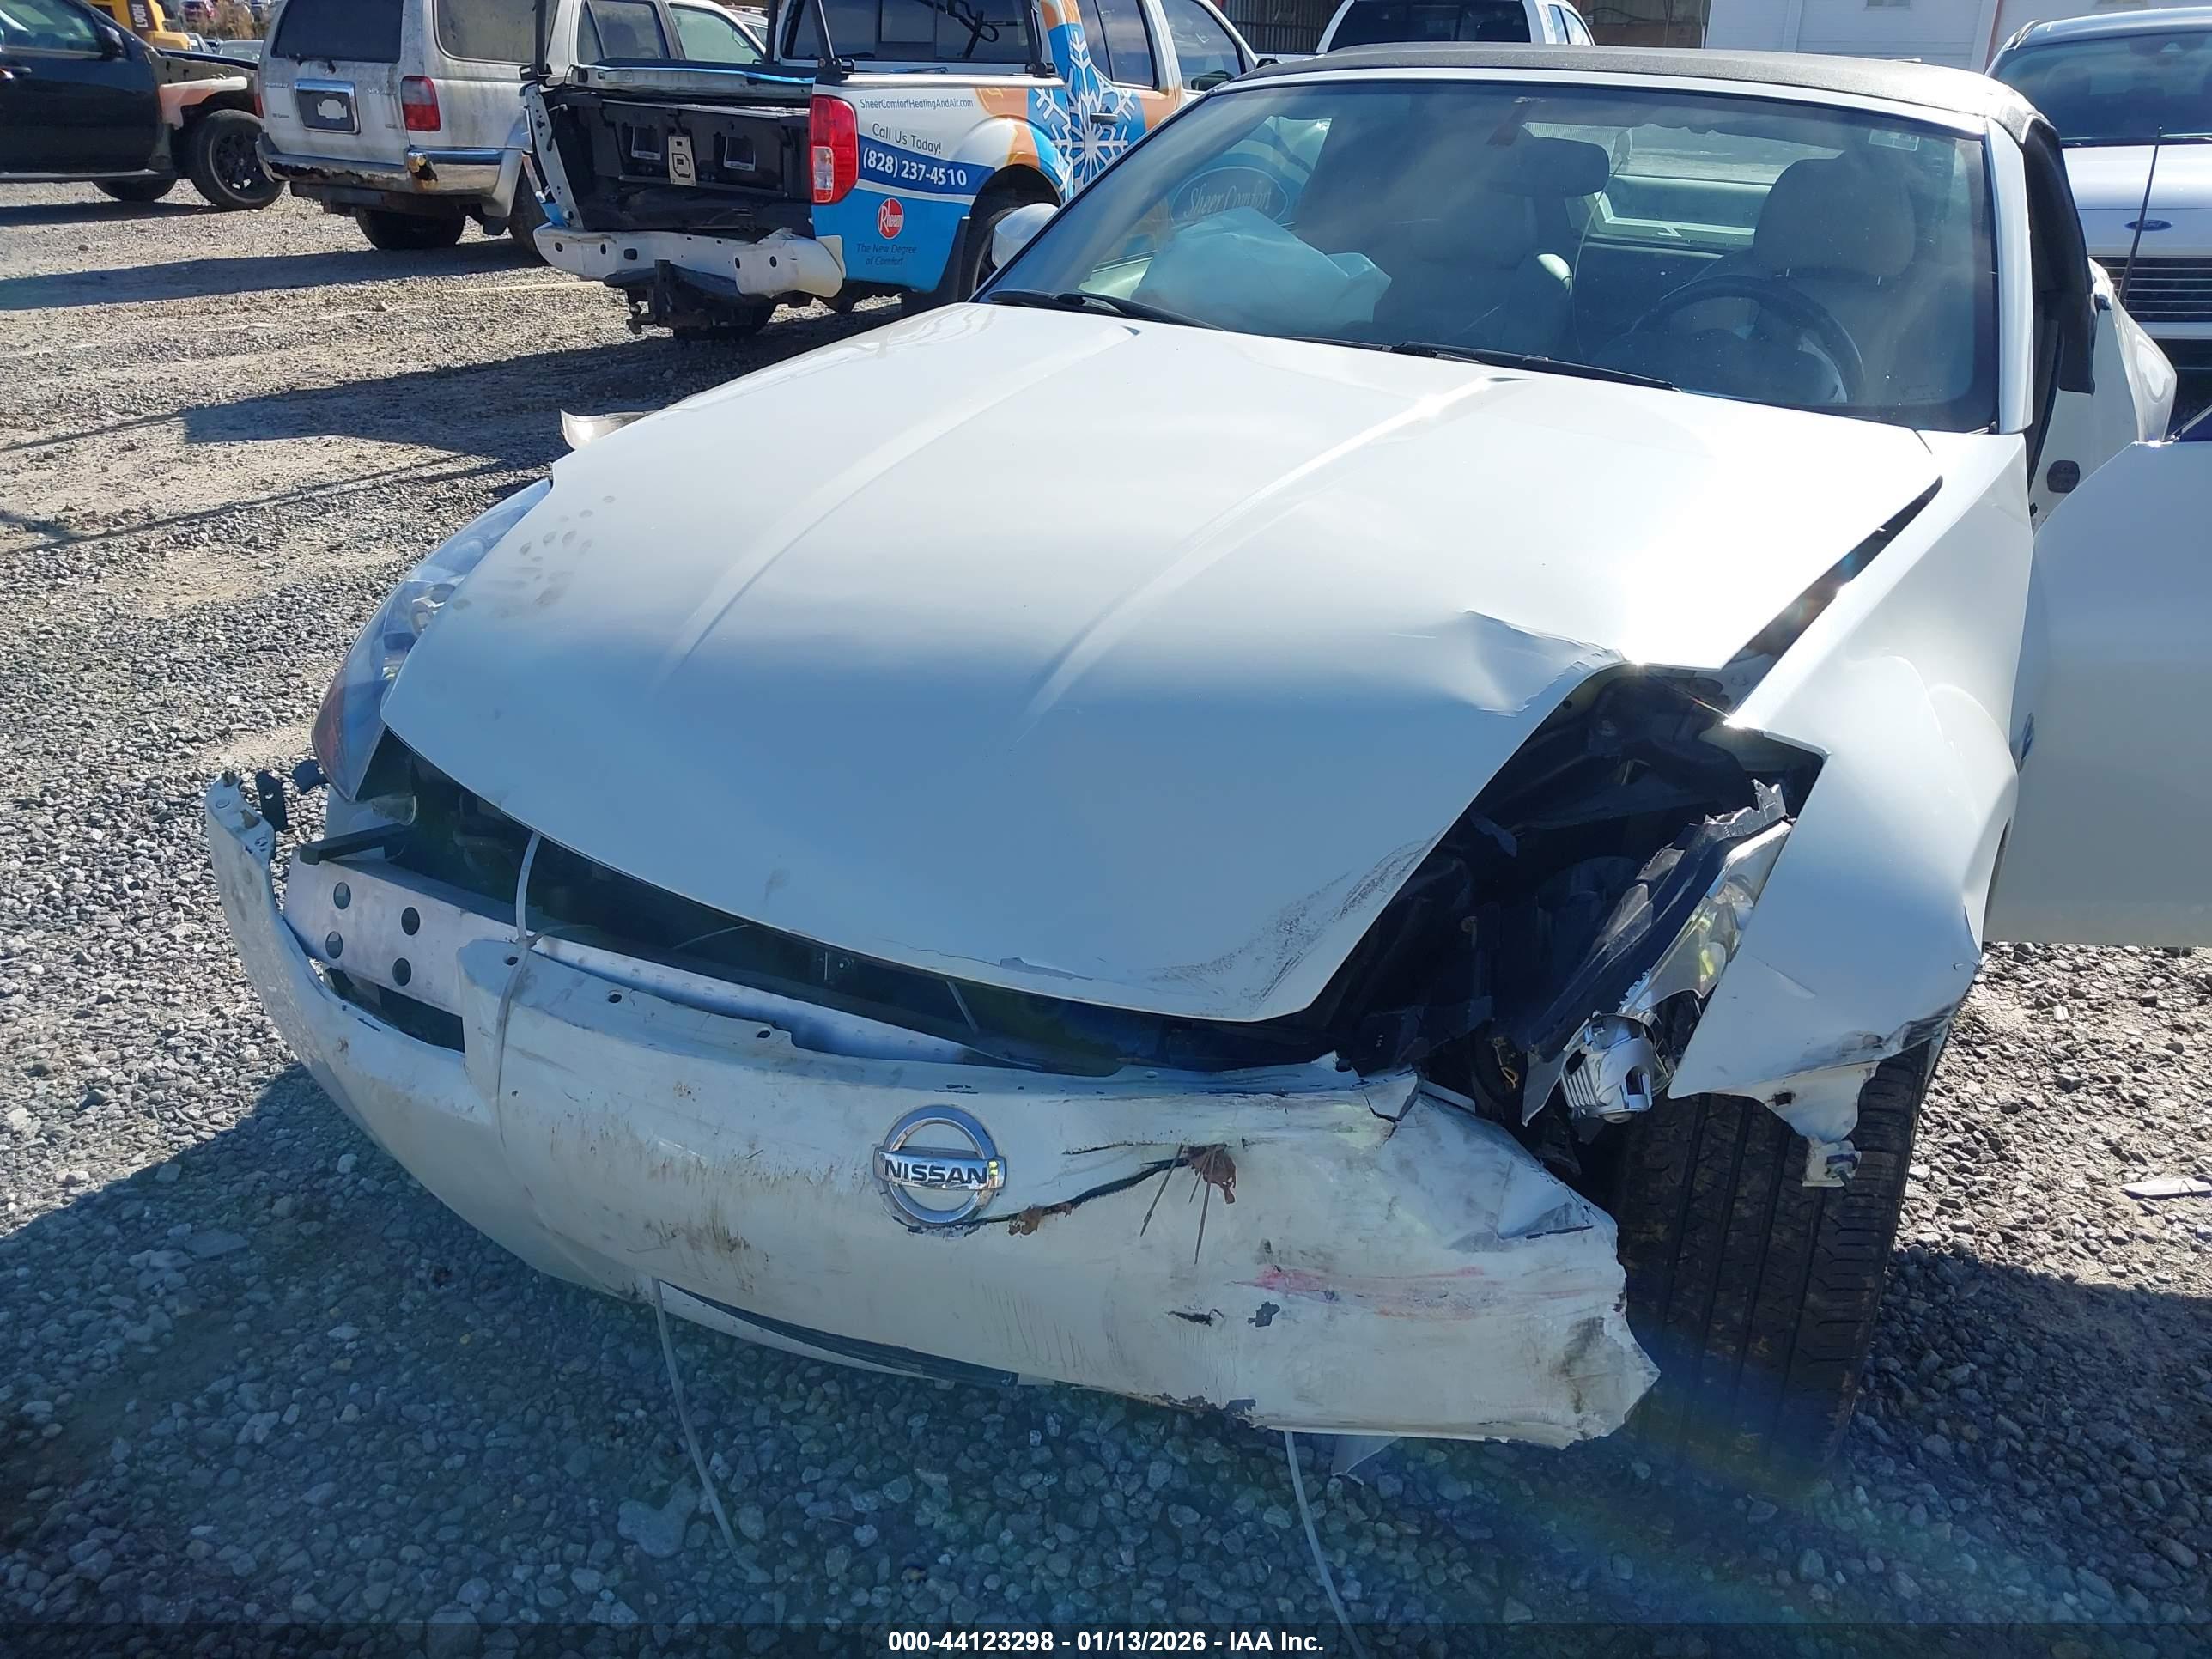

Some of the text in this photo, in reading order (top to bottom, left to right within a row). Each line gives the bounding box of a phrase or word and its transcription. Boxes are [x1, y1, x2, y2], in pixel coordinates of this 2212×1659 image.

[860, 98, 974, 111] SheerComfortHeatingAndAir.com
[872, 123, 942, 155] Call Us Today!
[863, 147, 968, 187] (828) 237-4510
[1183, 180, 1273, 218] Sheer Comfort
[879, 198, 902, 233] Rheem
[856, 243, 917, 255] The New Degree
[866, 257, 904, 266] of Comfort
[884, 1159, 988, 1184] NISSAN
